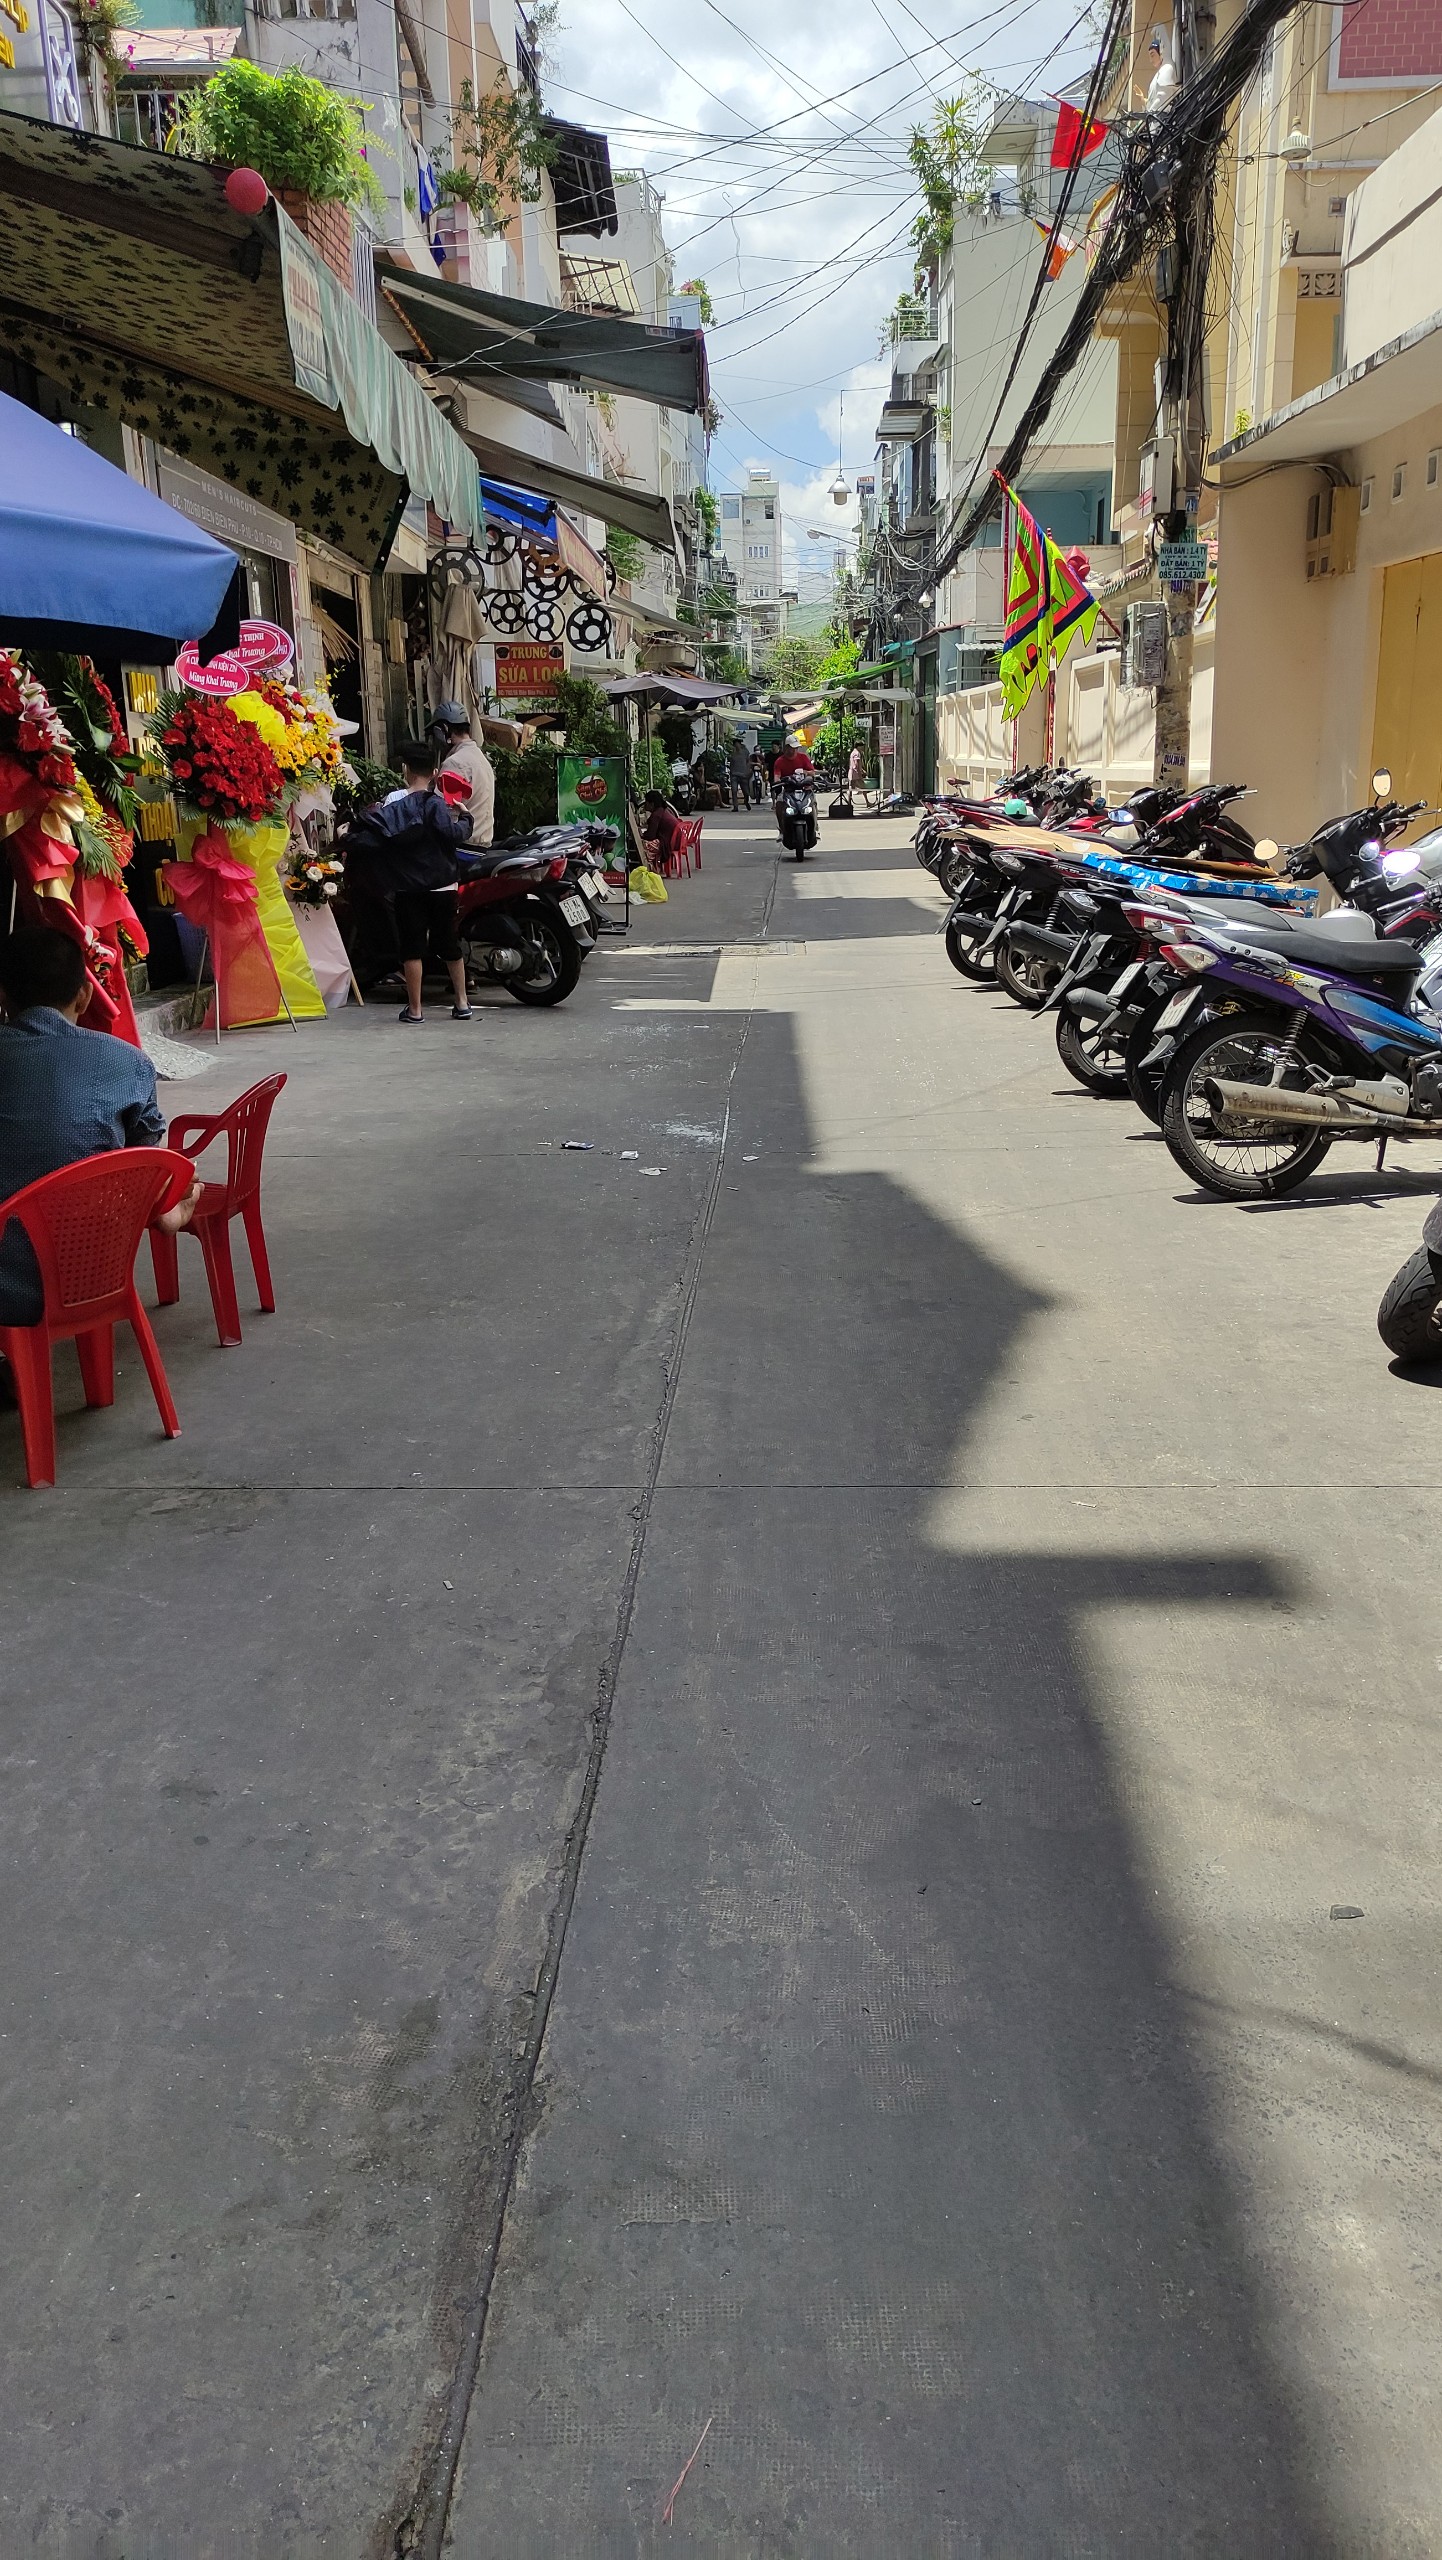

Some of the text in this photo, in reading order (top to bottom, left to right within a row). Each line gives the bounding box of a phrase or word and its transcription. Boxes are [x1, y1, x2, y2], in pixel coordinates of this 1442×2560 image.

[202, 481, 257, 516] MEN'S HAIRCUTS
[1161, 545, 1172, 554] NHÀ
[1173, 545, 1185, 554] BÁN
[243, 633, 264, 643] THỊNH
[511, 646, 548, 659] TRUNG
[229, 664, 238, 673] ZIN
[499, 662, 528, 684] SỬA
[130, 671, 158, 714] MUA
